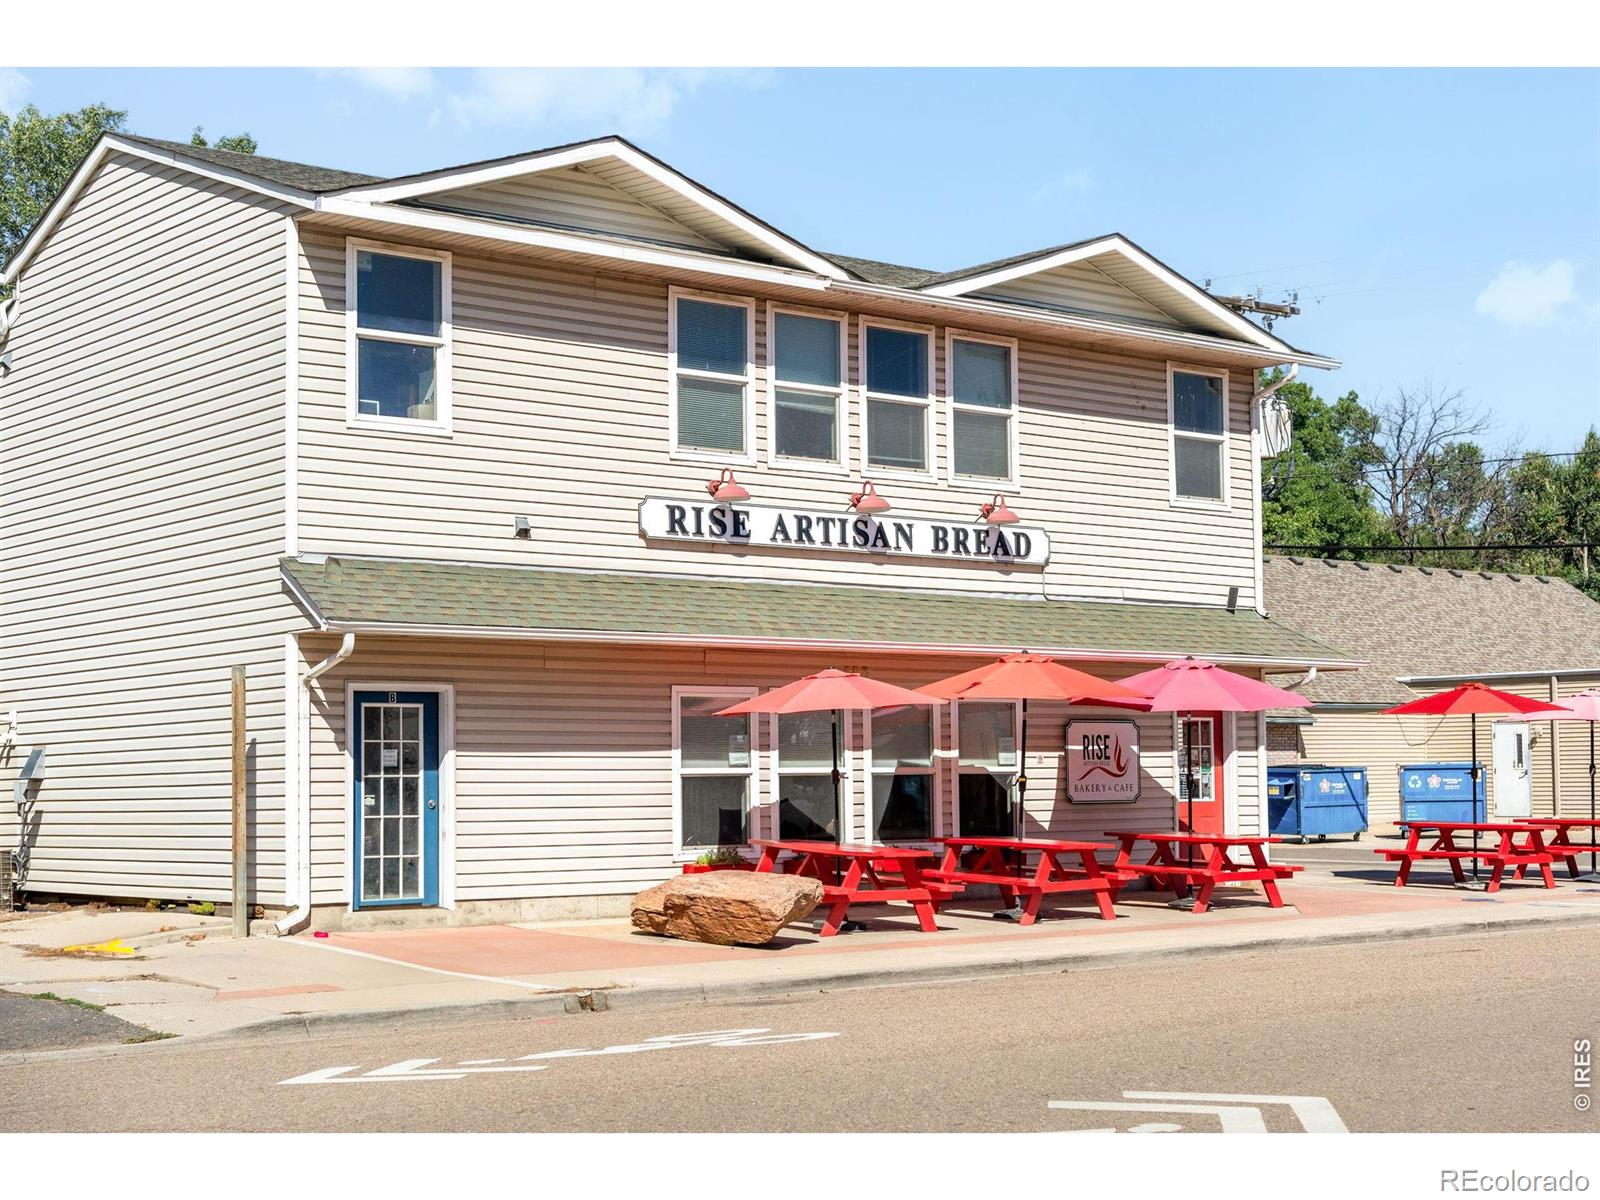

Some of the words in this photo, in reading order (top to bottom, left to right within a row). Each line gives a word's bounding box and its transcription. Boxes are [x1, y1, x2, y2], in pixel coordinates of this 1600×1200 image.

[666, 504, 751, 539] RISE
[770, 513, 914, 552] ARTISAN
[931, 525, 1033, 559] BREAD
[390, 693, 396, 703] B
[1082, 734, 1110, 760] RISE
[1074, 784, 1106, 793] BAKERY
